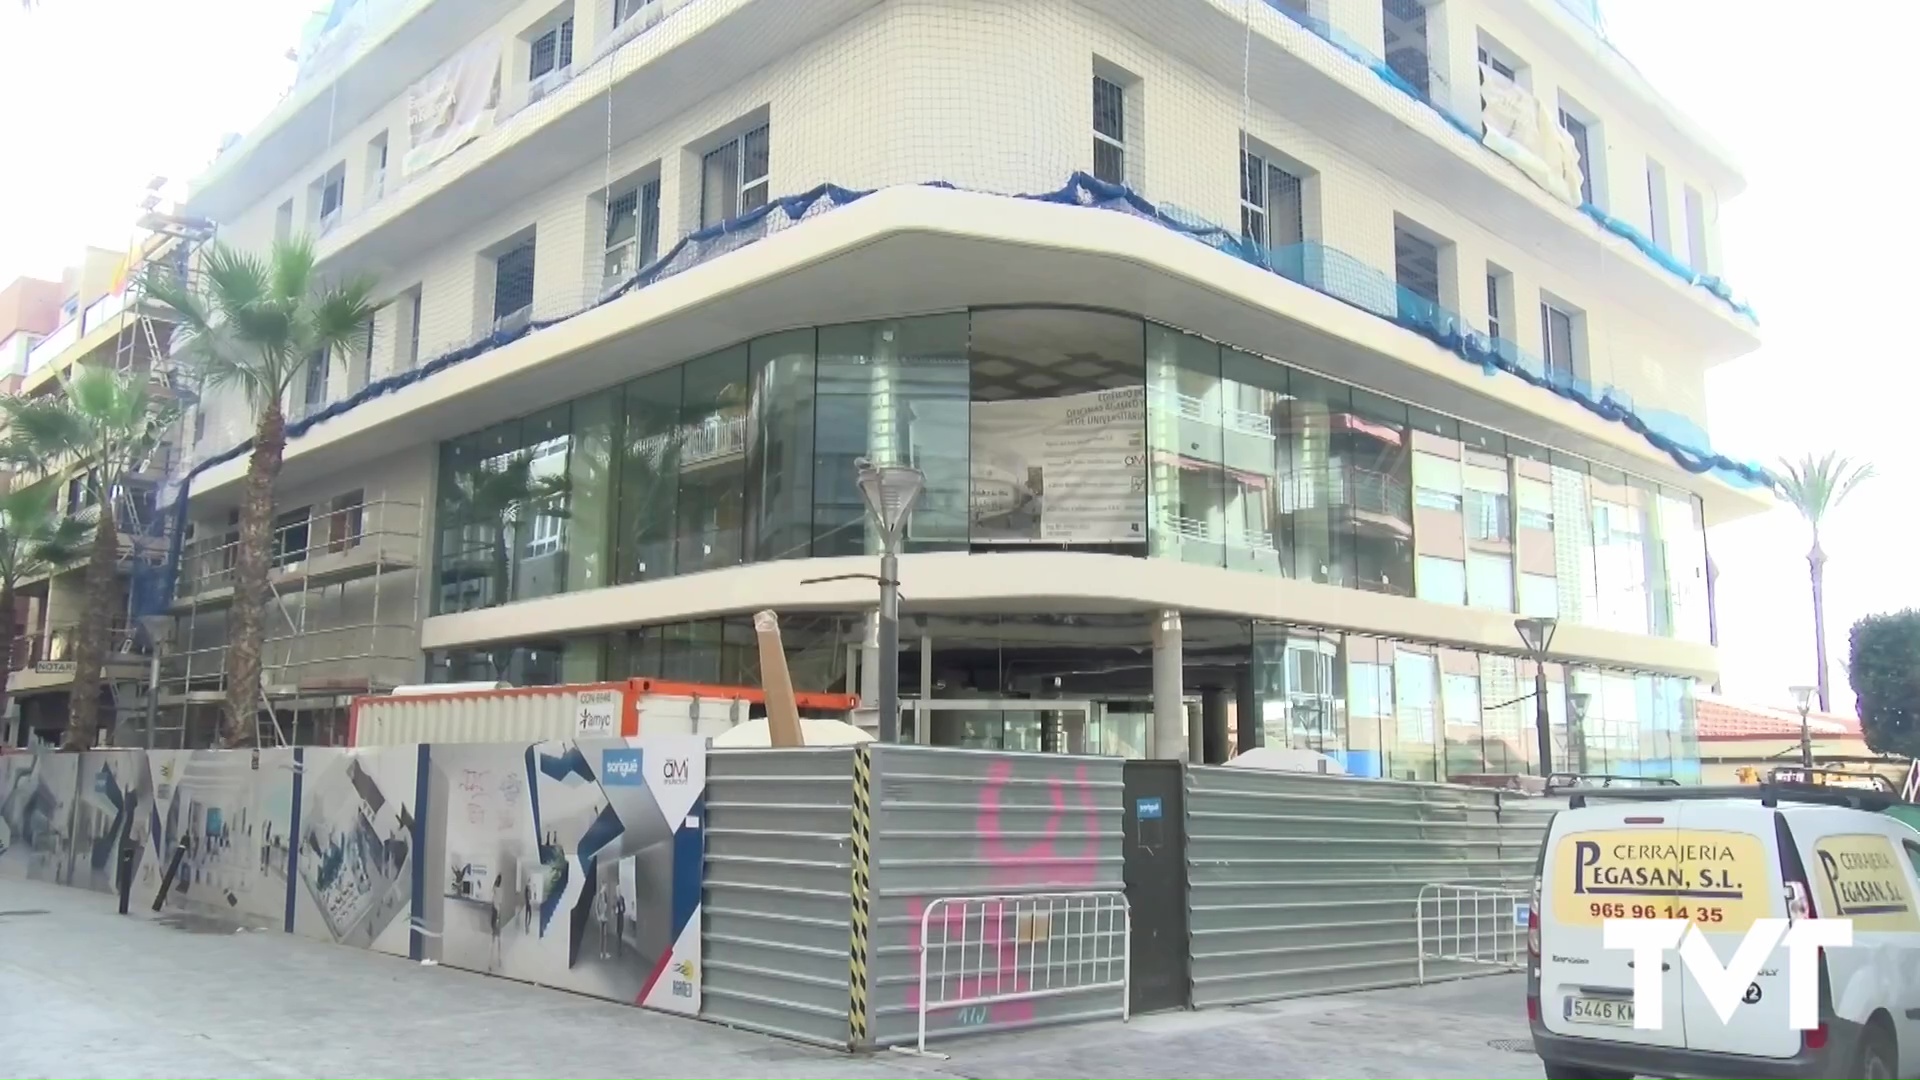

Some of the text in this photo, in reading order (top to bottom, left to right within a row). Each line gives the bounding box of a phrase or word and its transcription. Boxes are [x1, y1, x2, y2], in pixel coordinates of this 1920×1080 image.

[1574, 841, 1743, 894] PEGASAN, S.L.
[1589, 902, 1724, 923] 965 96 14 35
[1574, 1000, 1613, 1018] 5446
